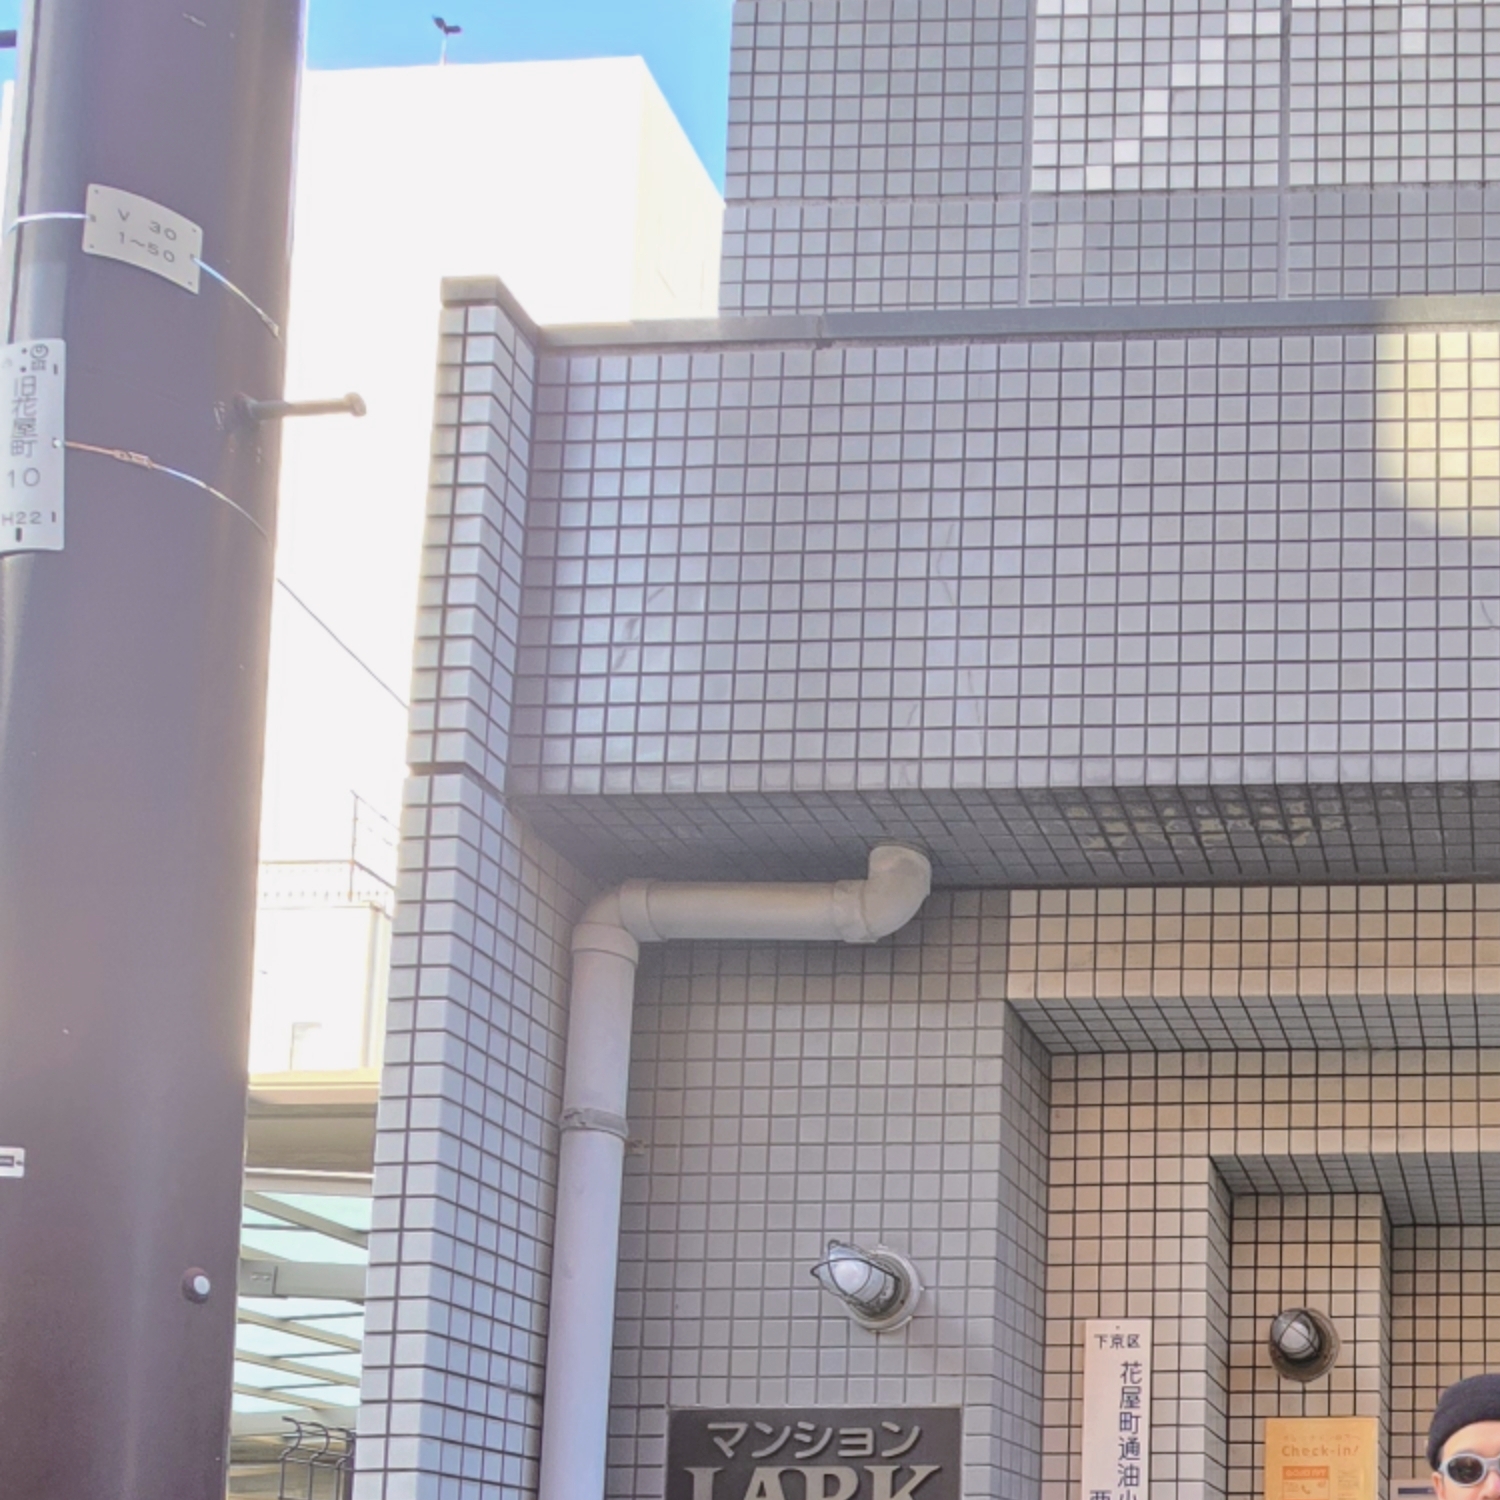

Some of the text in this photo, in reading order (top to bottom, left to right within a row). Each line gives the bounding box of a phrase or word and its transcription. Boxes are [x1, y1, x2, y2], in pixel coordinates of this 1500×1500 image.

[148, 221, 178, 241] 30
[1, 511, 42, 525] H22
[1093, 1333, 1141, 1349] 下京区
[707, 1420, 921, 1459] マンション
